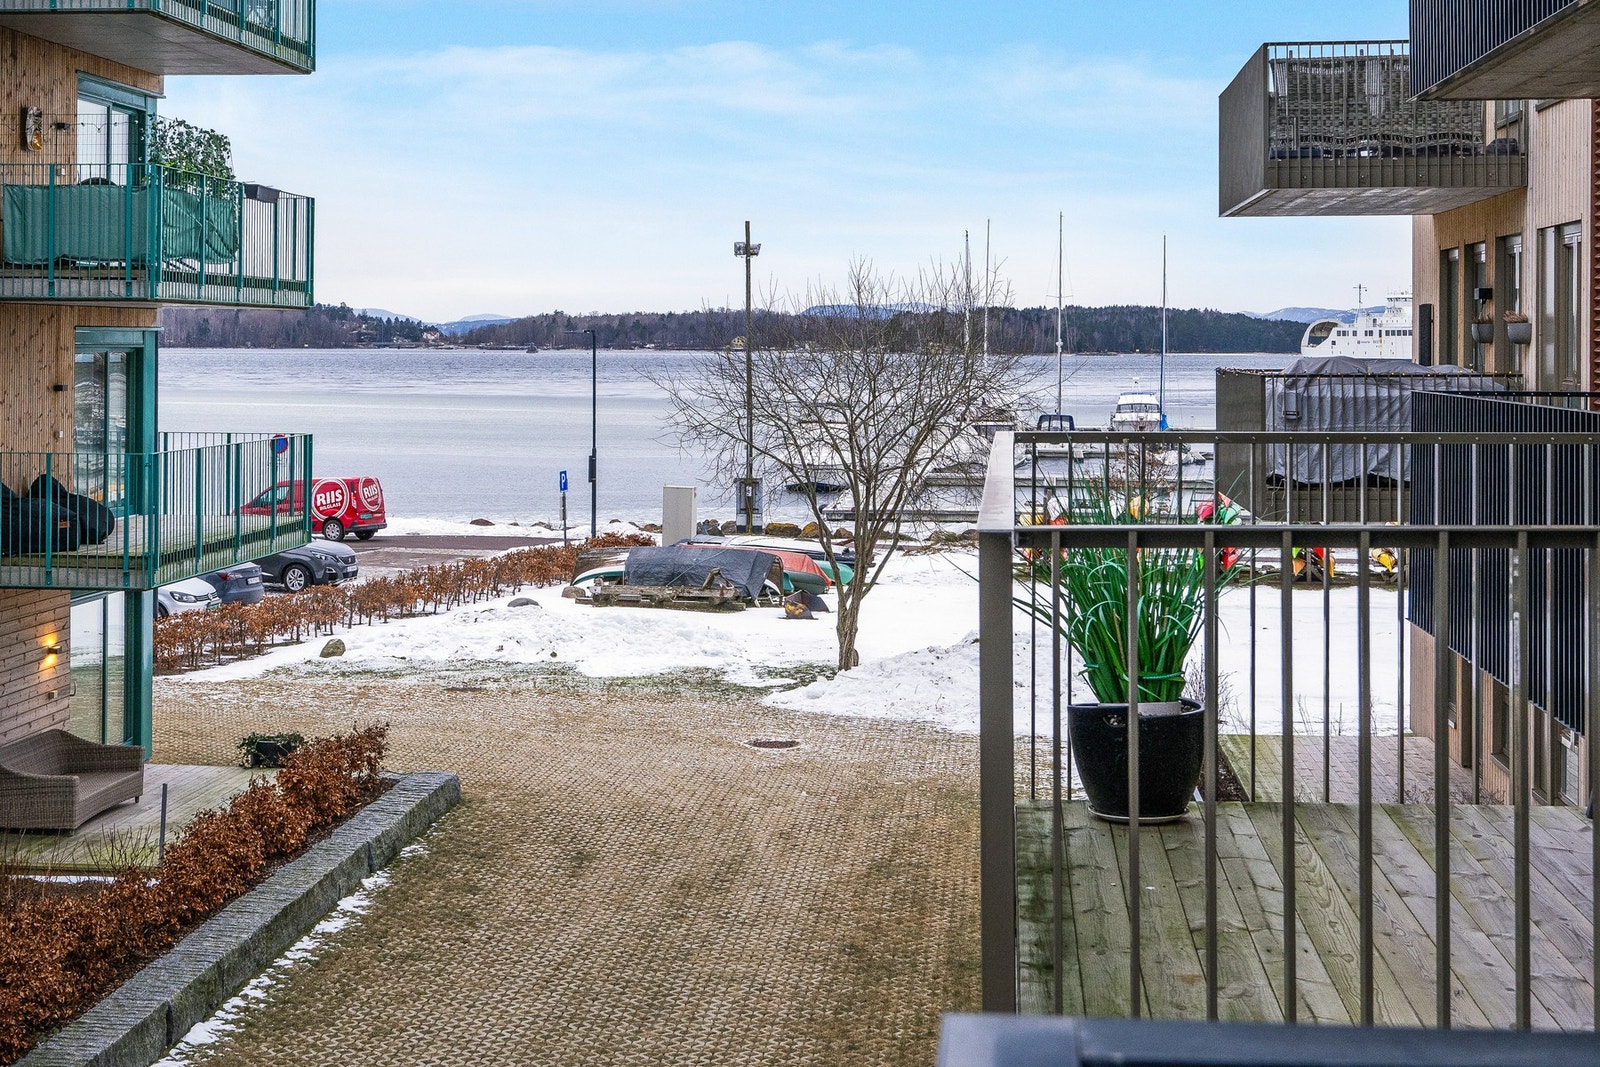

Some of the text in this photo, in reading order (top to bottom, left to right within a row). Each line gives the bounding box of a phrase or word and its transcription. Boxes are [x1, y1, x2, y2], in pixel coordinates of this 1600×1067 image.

[561, 473, 566, 489] P
[316, 489, 343, 507] RIIS
[363, 484, 378, 499] RIIS
